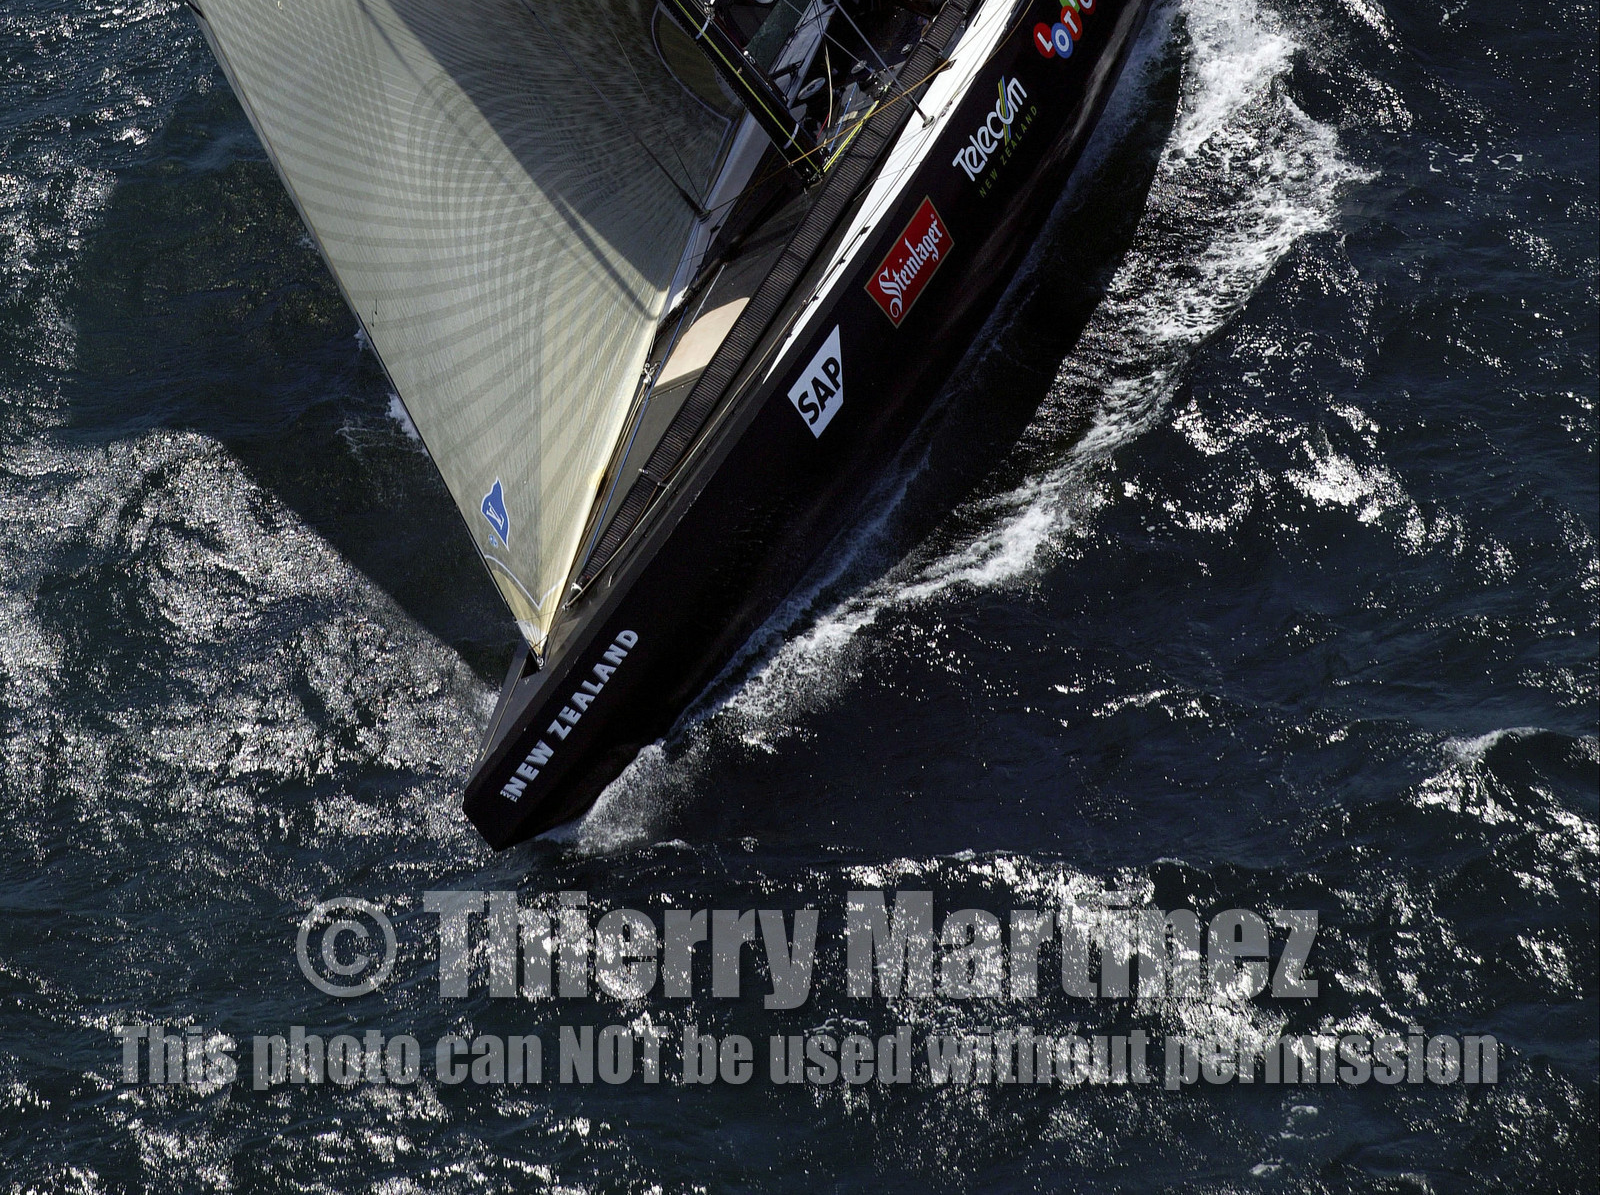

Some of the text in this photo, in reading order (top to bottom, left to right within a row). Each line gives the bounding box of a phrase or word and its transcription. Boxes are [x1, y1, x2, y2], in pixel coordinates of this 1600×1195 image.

[952, 77, 1028, 182] Telecom
[979, 105, 1038, 199] NEW ZEALAND
[797, 356, 842, 426] SAP
[503, 629, 639, 799] NEW ZEALAND
